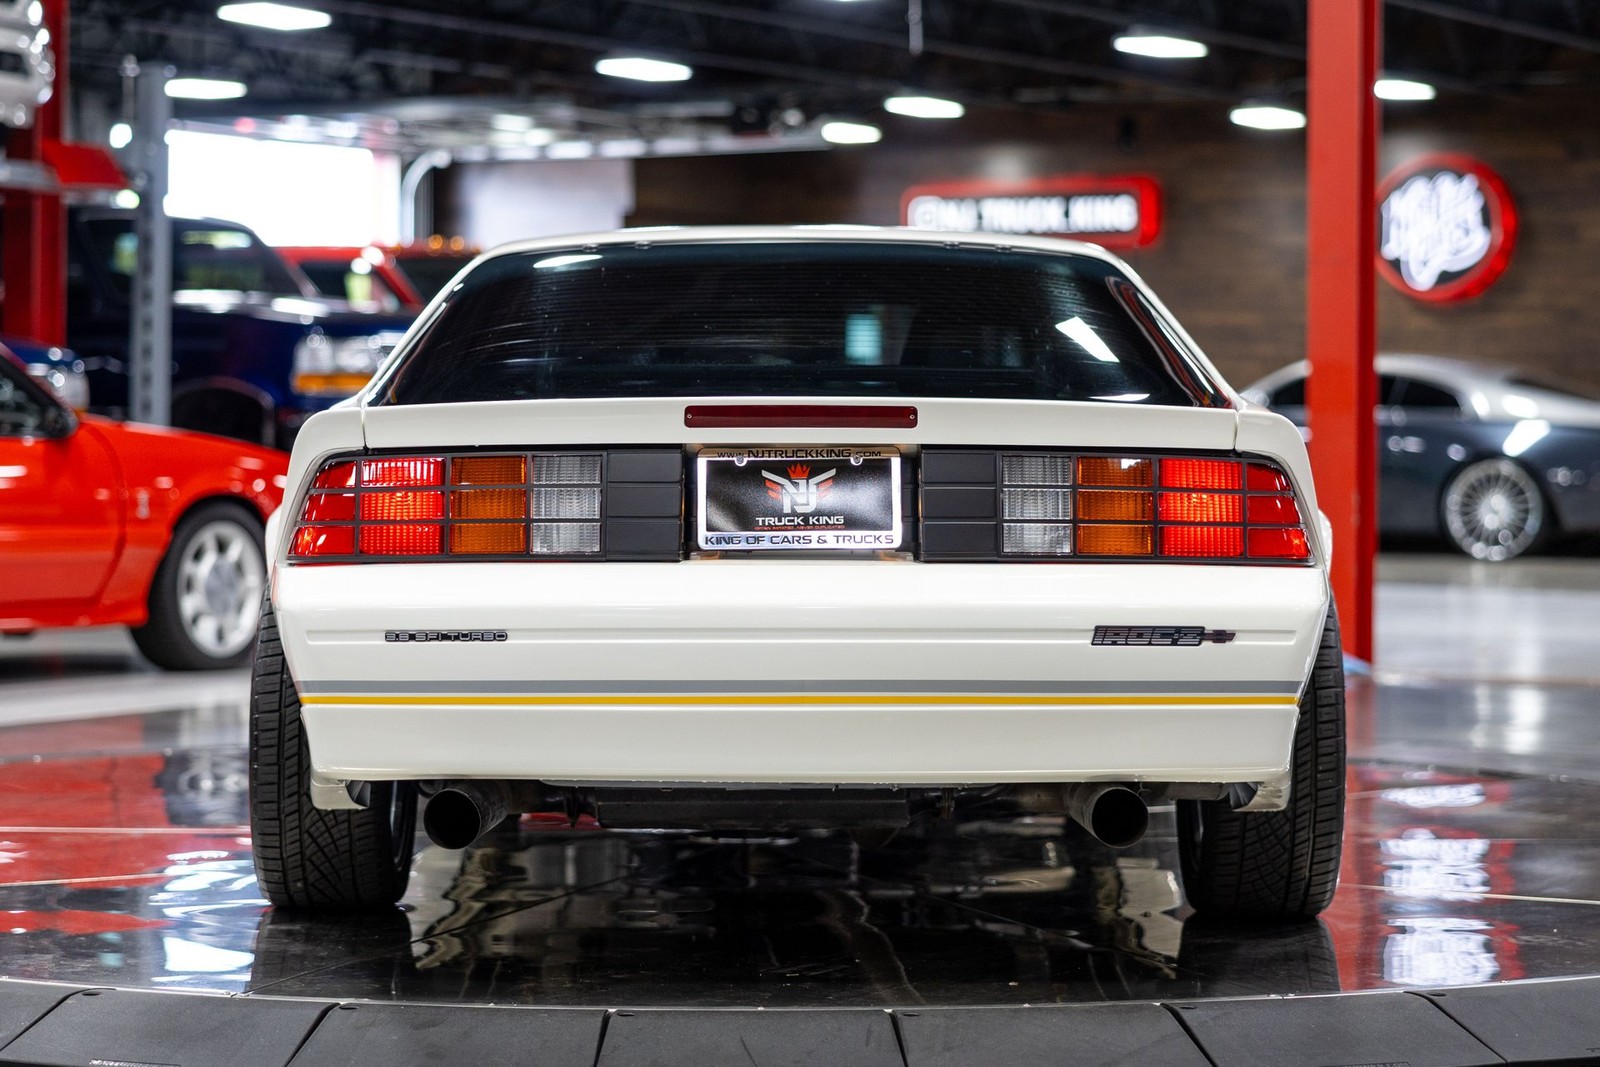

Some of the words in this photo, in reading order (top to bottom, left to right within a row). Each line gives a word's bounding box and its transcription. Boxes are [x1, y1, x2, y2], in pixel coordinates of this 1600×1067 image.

[755, 516, 805, 526] TRUCK
[809, 515, 845, 525] KING
[704, 535, 742, 545] KING
[746, 535, 766, 545] OF
[770, 535, 812, 545] CARS
[816, 535, 828, 544] &
[833, 534, 894, 544] TRUCKS
[385, 631, 410, 642] 3.8
[414, 631, 443, 642] SFI
[446, 630, 508, 642] TURBO
